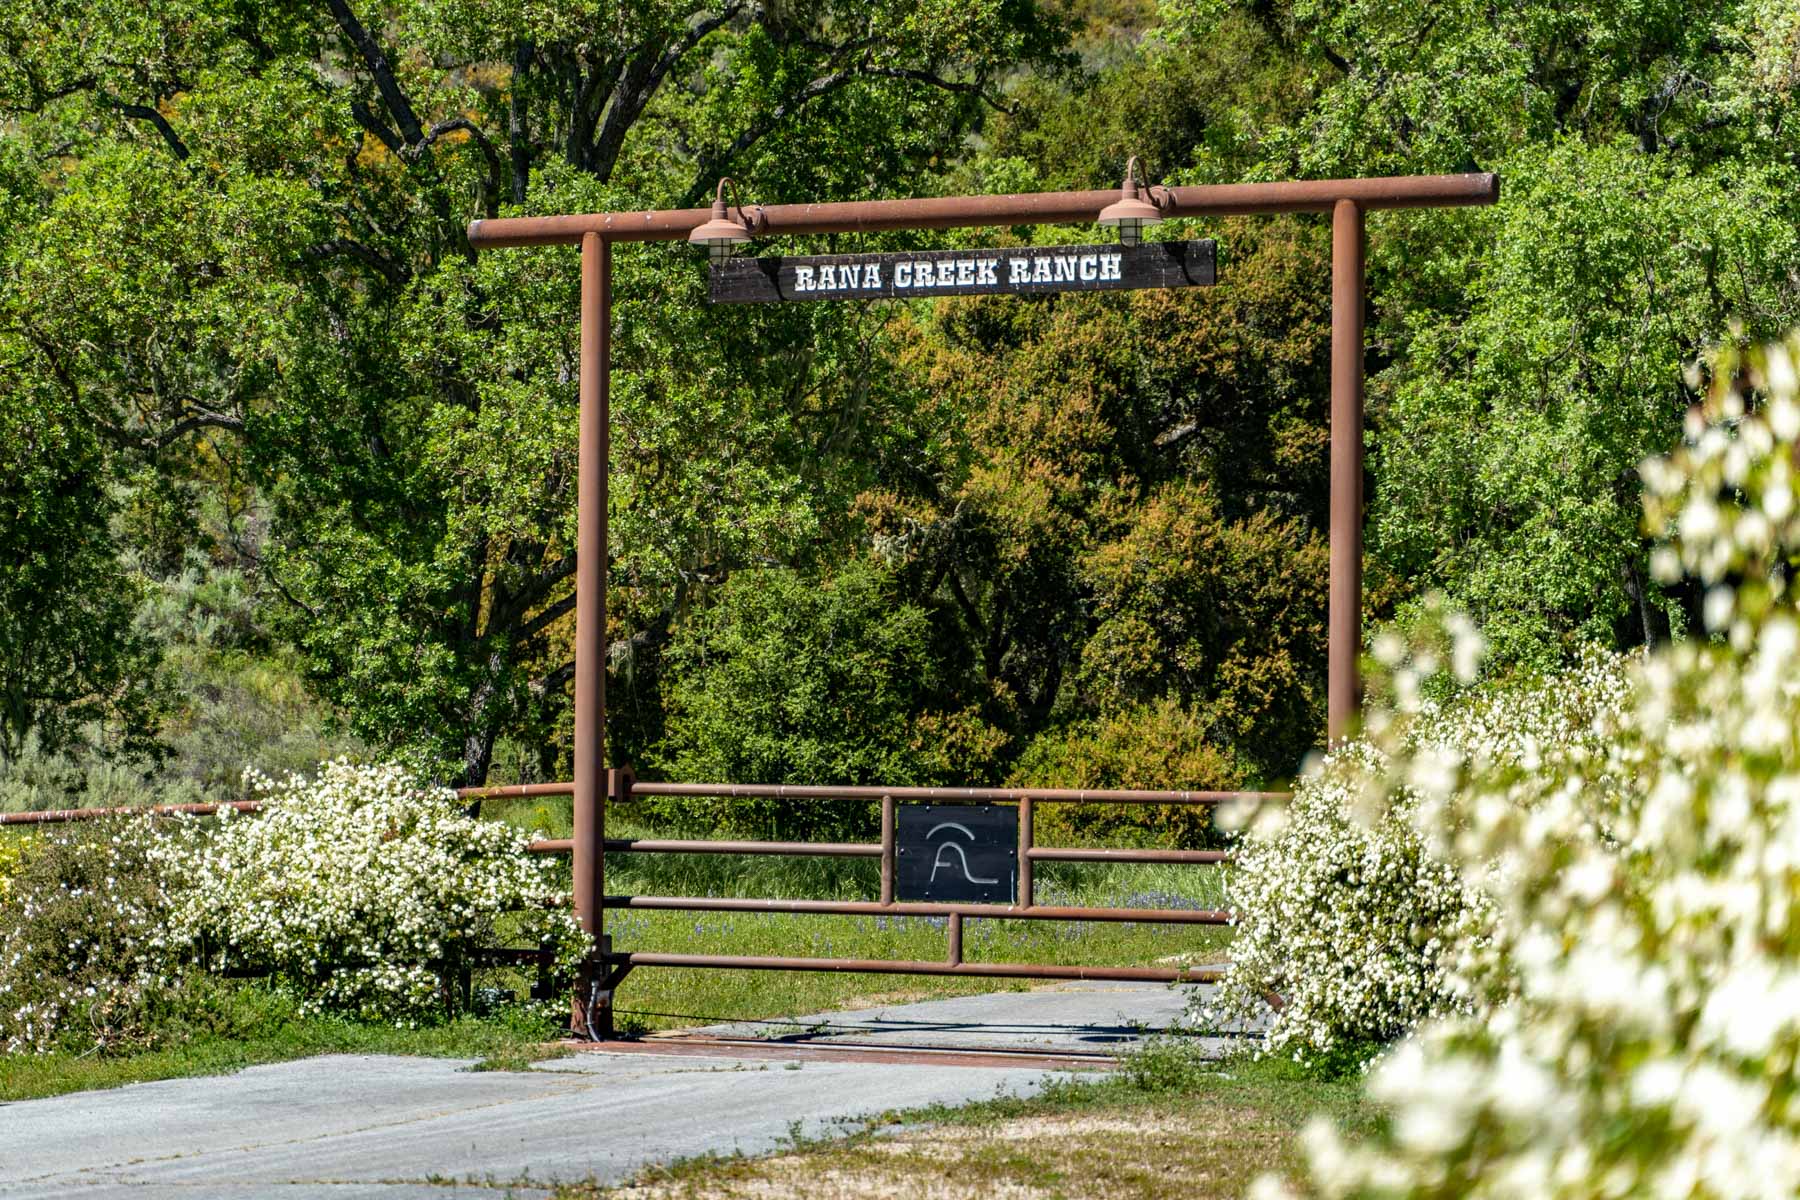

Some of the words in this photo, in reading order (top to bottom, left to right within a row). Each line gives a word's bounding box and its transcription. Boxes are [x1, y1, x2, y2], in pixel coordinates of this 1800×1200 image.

[794, 263, 882, 292] RANA
[894, 258, 998, 288] CREEK
[1008, 253, 1122, 283] RANCH
